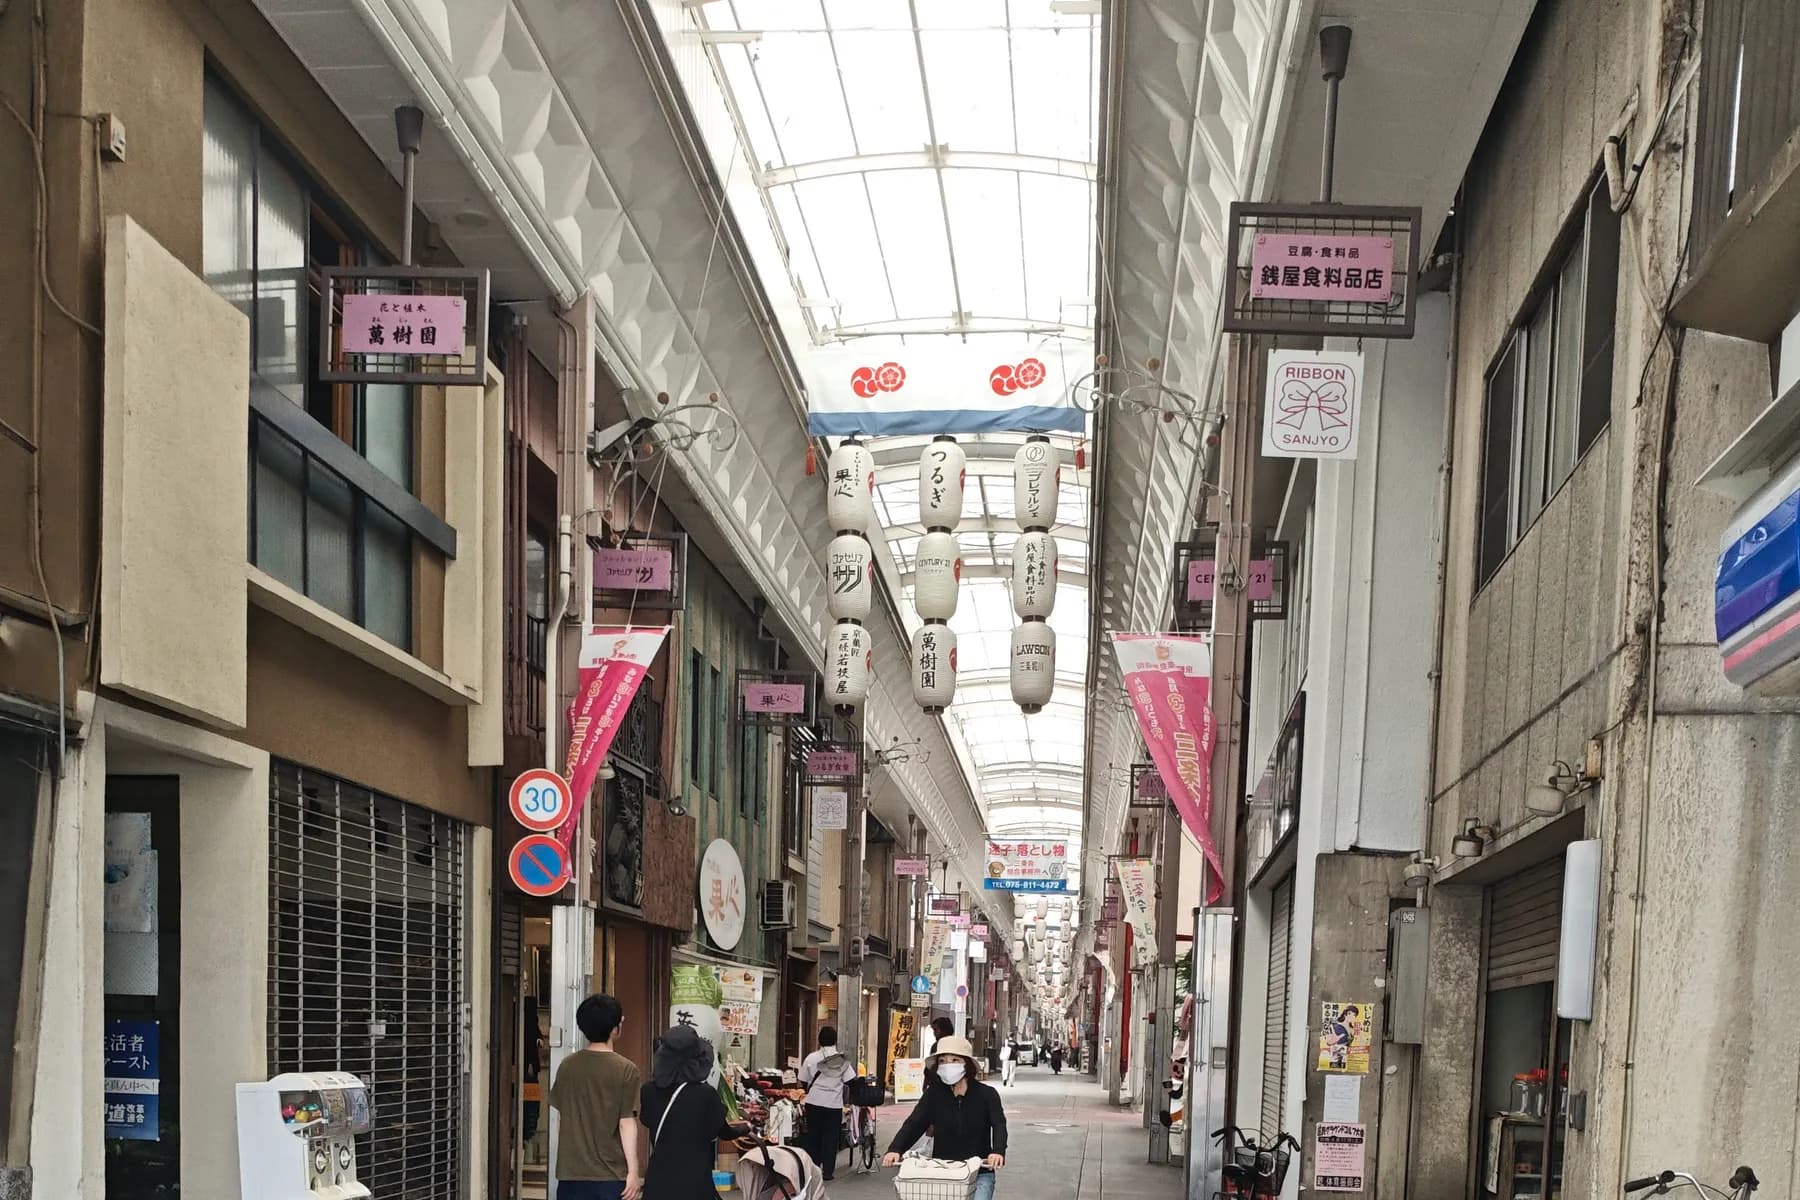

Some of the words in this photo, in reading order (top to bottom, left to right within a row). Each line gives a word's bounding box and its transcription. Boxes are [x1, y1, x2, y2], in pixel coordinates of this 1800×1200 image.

[1288, 246, 1360, 258] 豆腐・食料品
[1261, 265, 1384, 289] 銭屋食料品店
[1286, 367, 1345, 380] RIBBON
[1283, 434, 1339, 446] SANJYO
[931, 451, 947, 509] つるぎ
[1256, 574, 1266, 583] 21
[1016, 644, 1050, 656] LAWSON
[525, 787, 557, 812] 30
